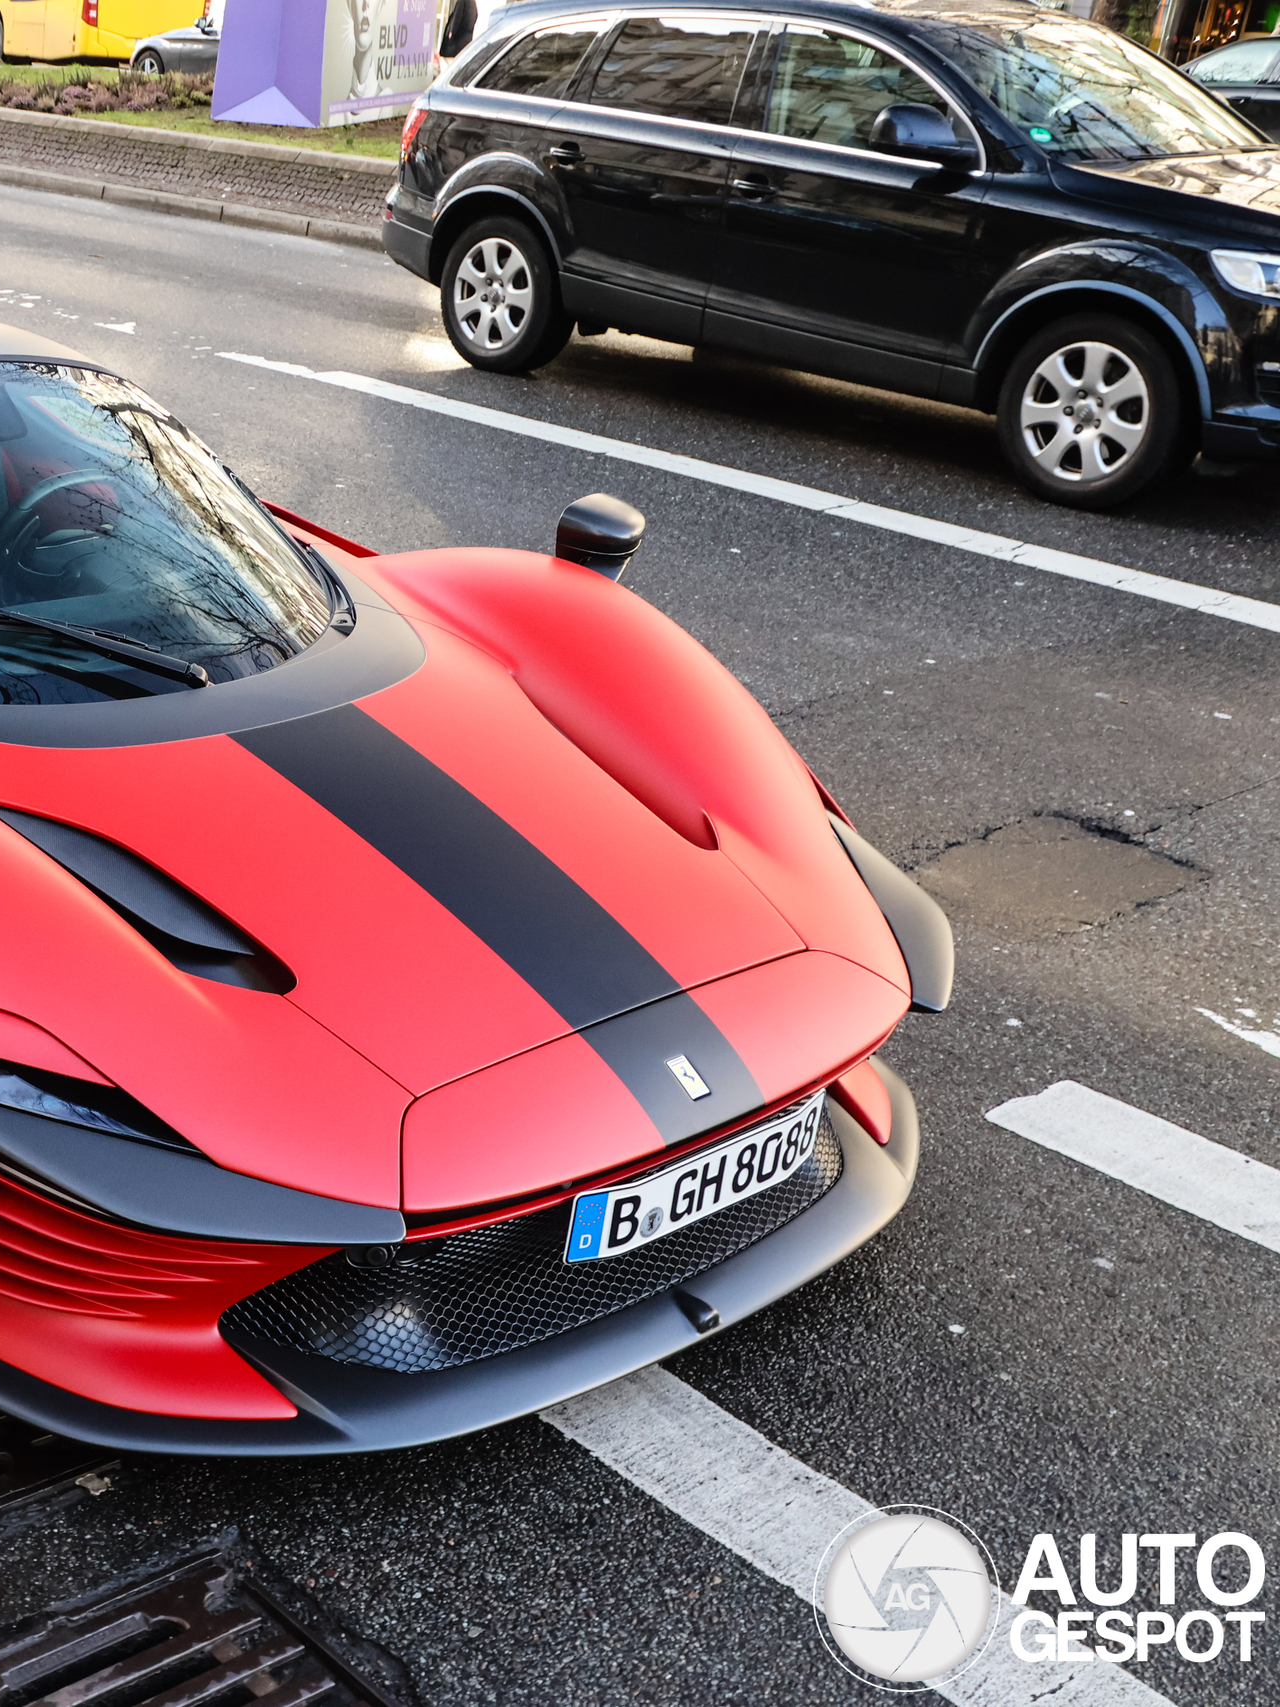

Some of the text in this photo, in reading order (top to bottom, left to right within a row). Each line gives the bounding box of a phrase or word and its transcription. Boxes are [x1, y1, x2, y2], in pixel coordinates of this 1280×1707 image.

[378, 24, 408, 49] BLVD
[376, 52, 429, 81] KU'DAMM
[607, 1106, 818, 1248] B GH 8088
[579, 1233, 592, 1249] D
